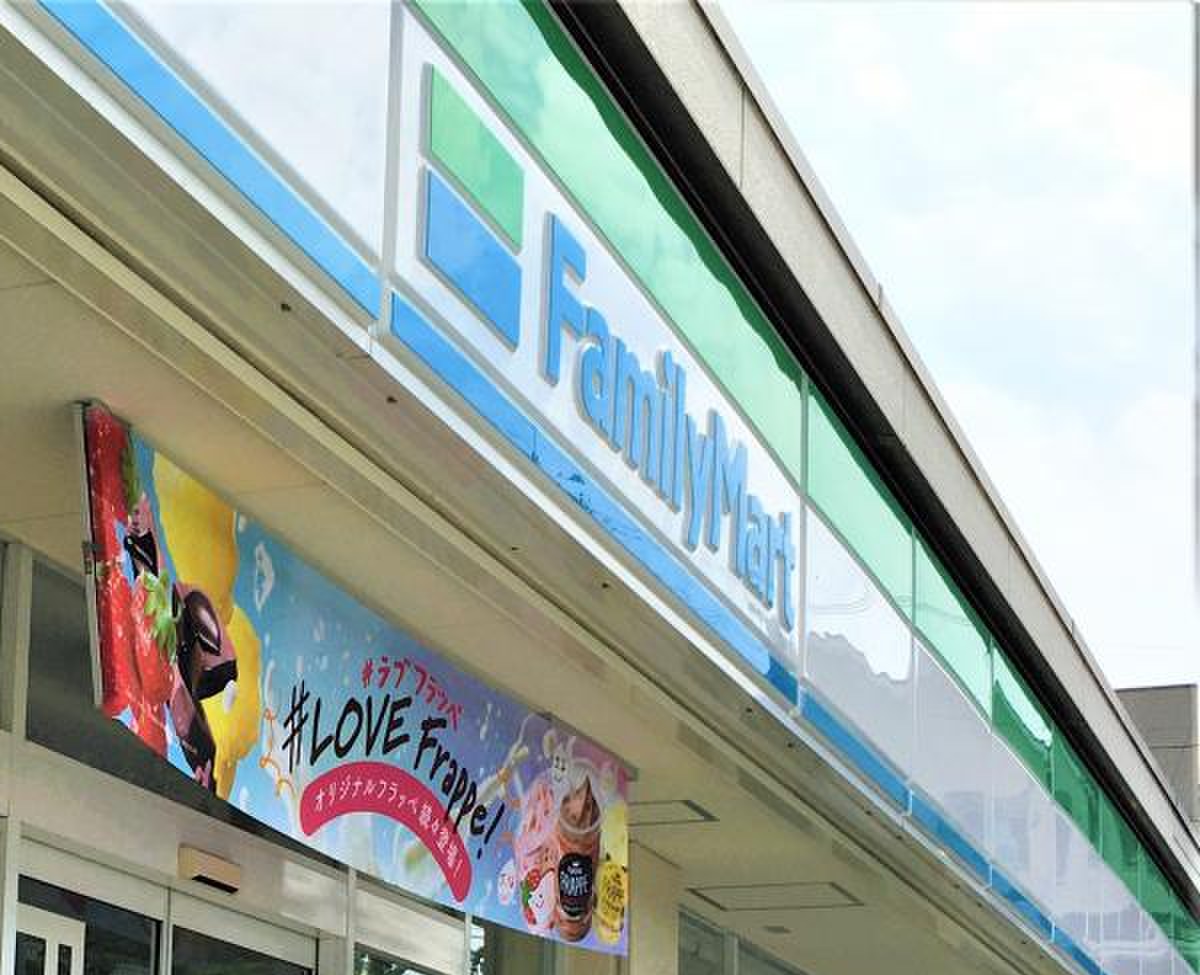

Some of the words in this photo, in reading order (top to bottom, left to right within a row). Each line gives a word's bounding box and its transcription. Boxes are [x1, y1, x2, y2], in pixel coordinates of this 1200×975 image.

[543, 210, 797, 633] FamilyMart
[282, 680, 413, 773] #LOVE
[413, 715, 505, 859] Frappe!
